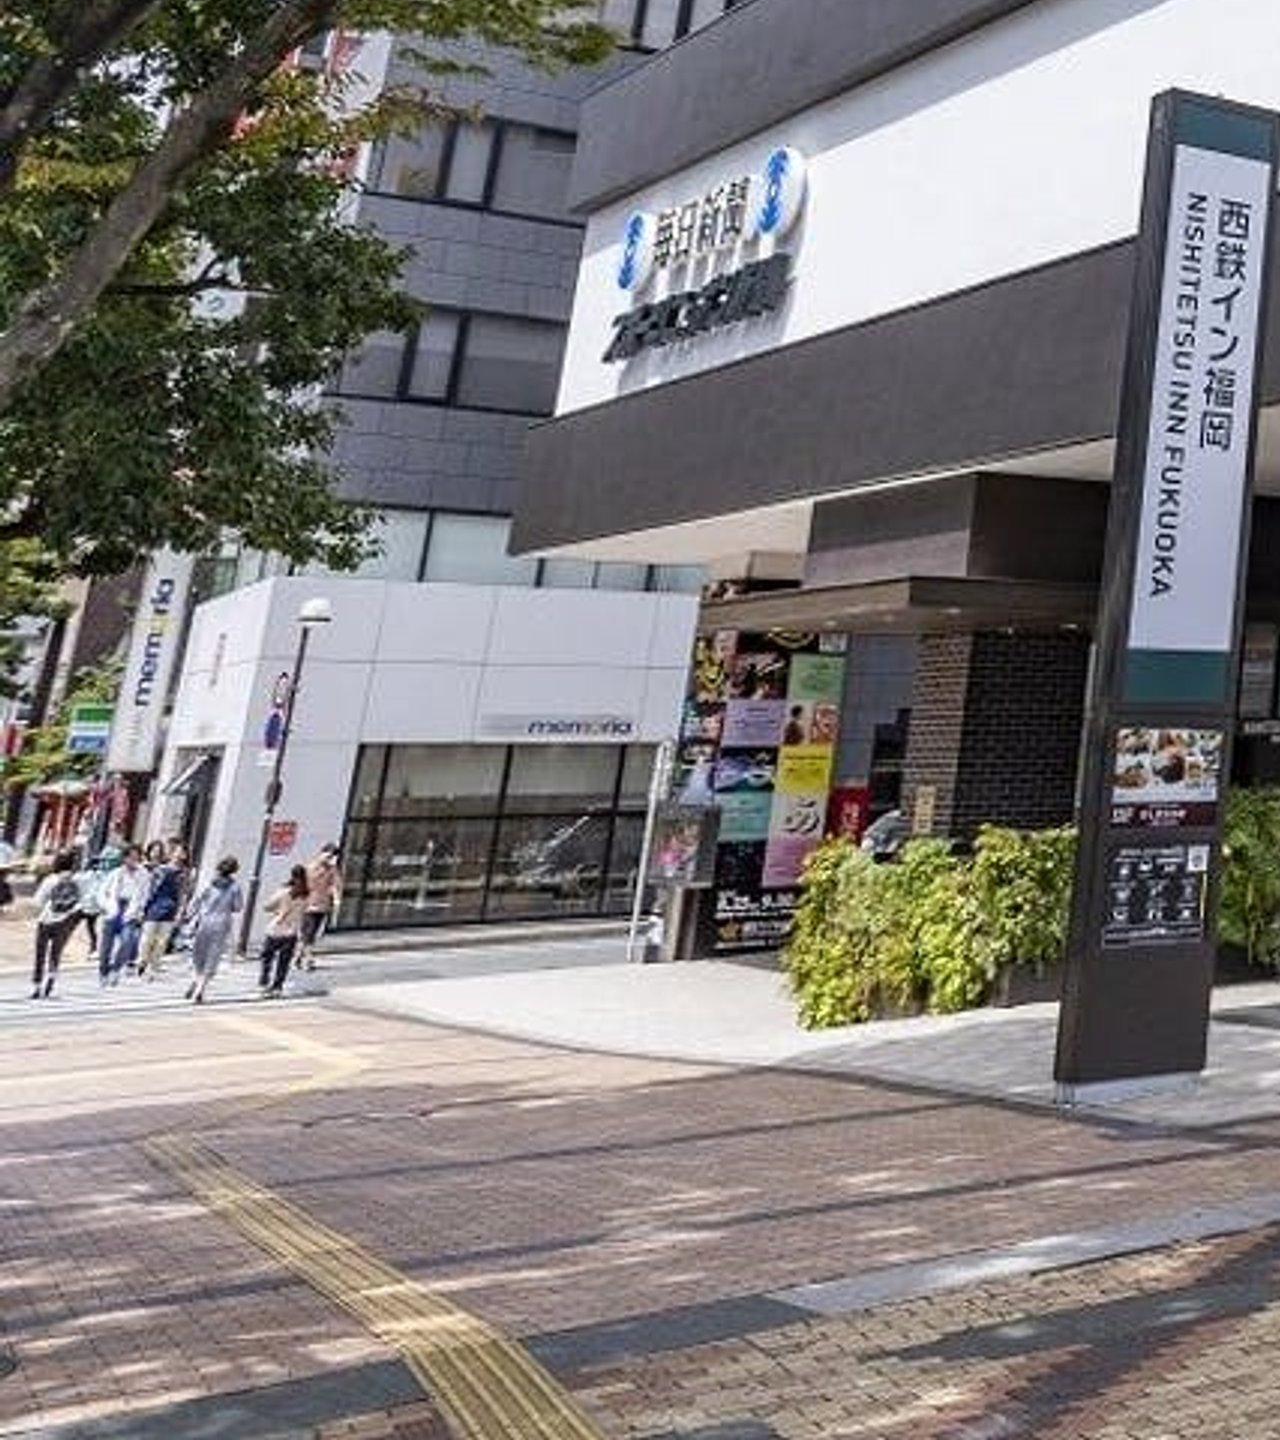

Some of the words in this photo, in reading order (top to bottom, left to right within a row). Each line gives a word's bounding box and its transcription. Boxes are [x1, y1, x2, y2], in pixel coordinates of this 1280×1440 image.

[1172, 192, 1208, 370] NISHITETSU
[1199, 196, 1252, 452] 西鉄イン福岡
[1165, 381, 1193, 434] INN
[1150, 446, 1186, 598] FUKUOKA
